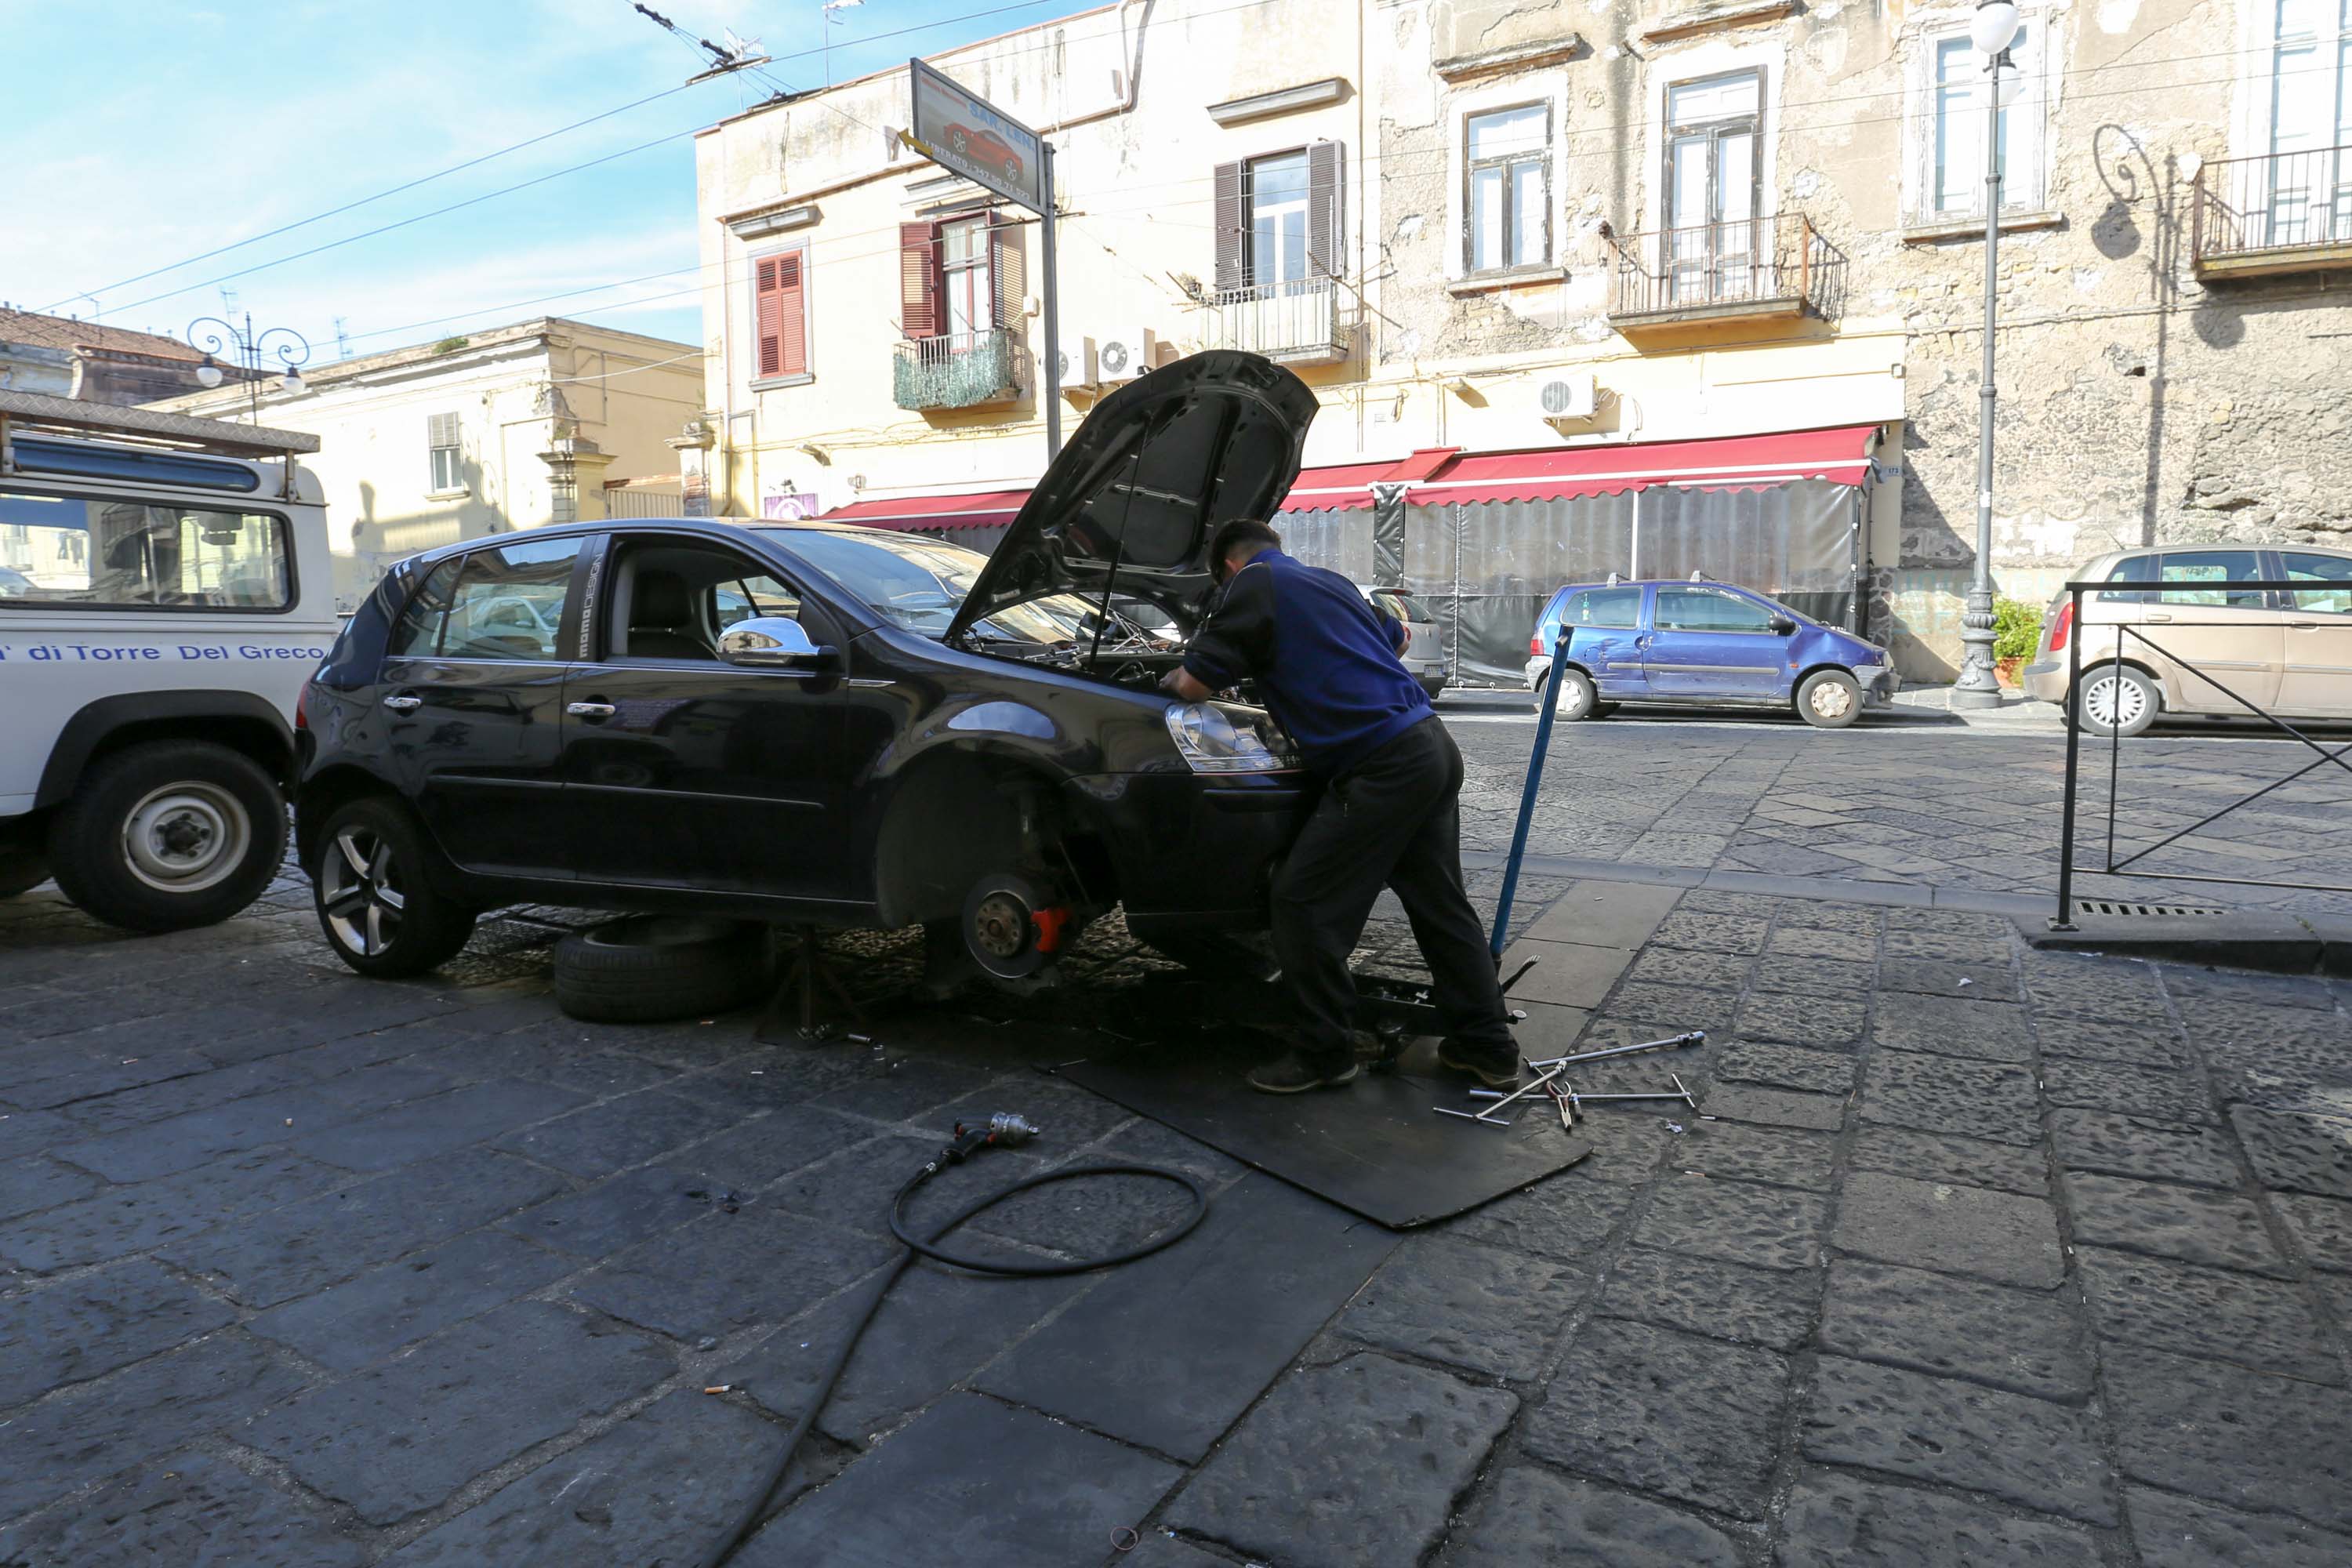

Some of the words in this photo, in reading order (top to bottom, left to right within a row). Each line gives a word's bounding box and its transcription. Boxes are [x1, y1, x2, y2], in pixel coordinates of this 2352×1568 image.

[28, 645, 63, 660] di
[67, 645, 162, 660] Torre
[177, 645, 229, 660] Del
[238, 645, 325, 660] Greco
